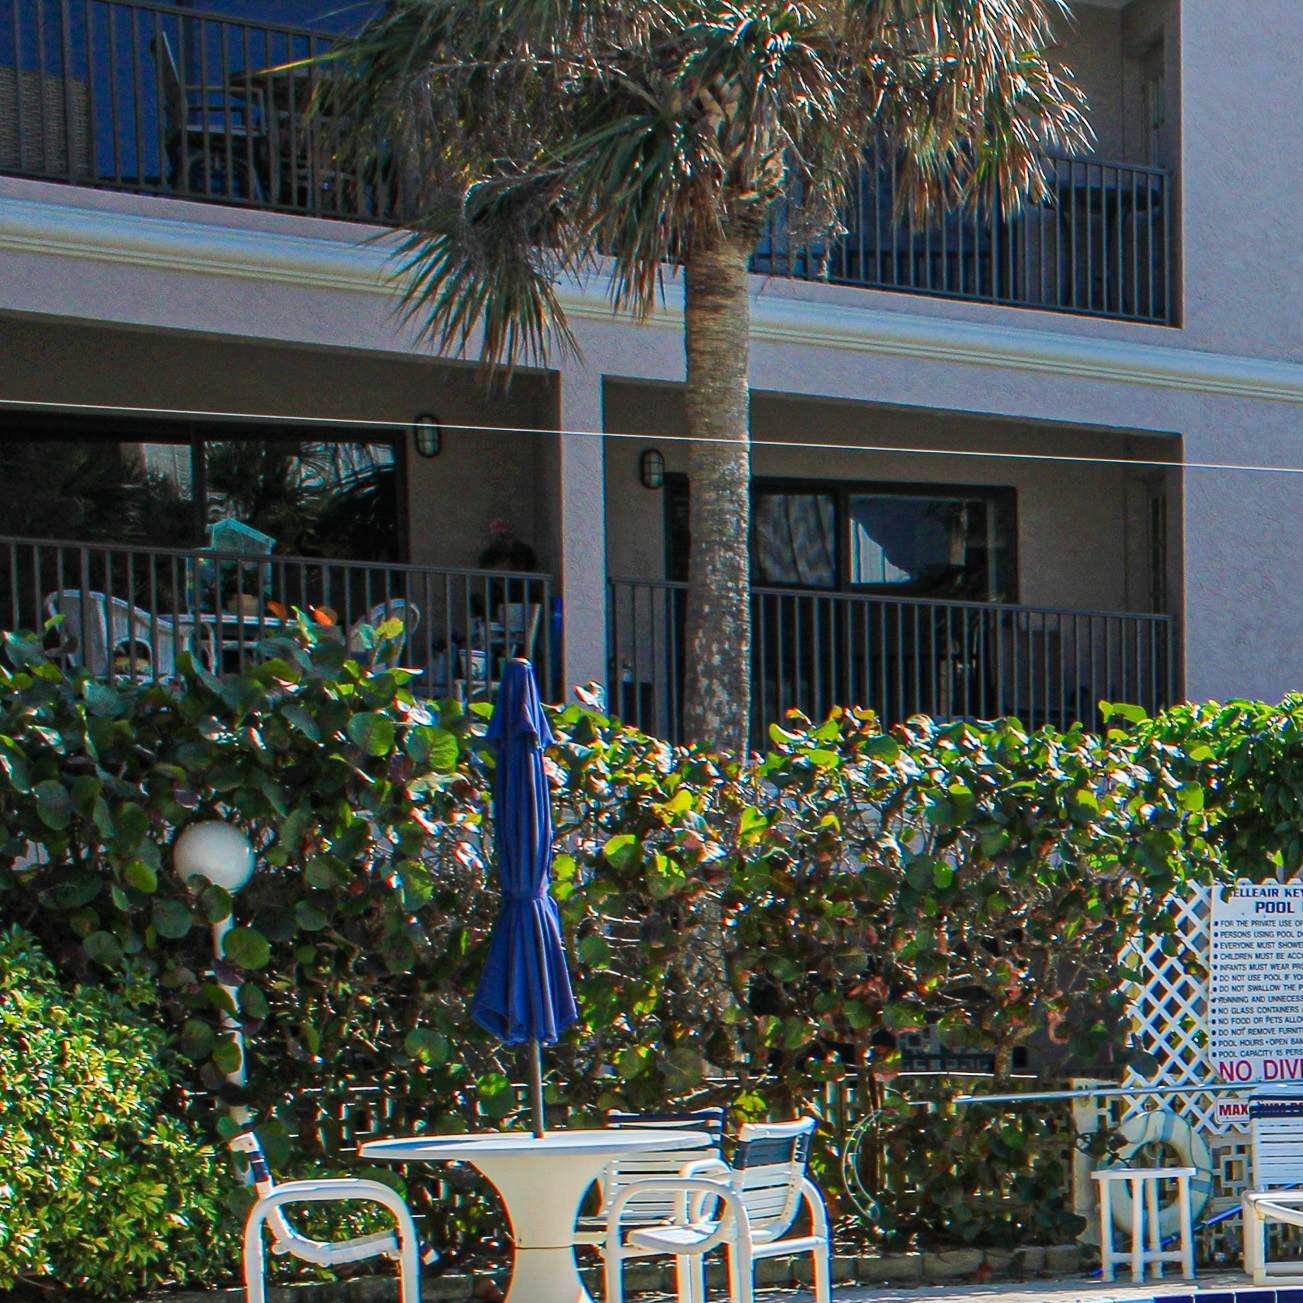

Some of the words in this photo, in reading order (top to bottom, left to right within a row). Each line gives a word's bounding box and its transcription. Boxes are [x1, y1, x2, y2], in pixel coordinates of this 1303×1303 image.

[1232, 889, 1279, 897] ELLEAIR
[1256, 902, 1294, 913] POOL
[1220, 1060, 1252, 1080] NO
